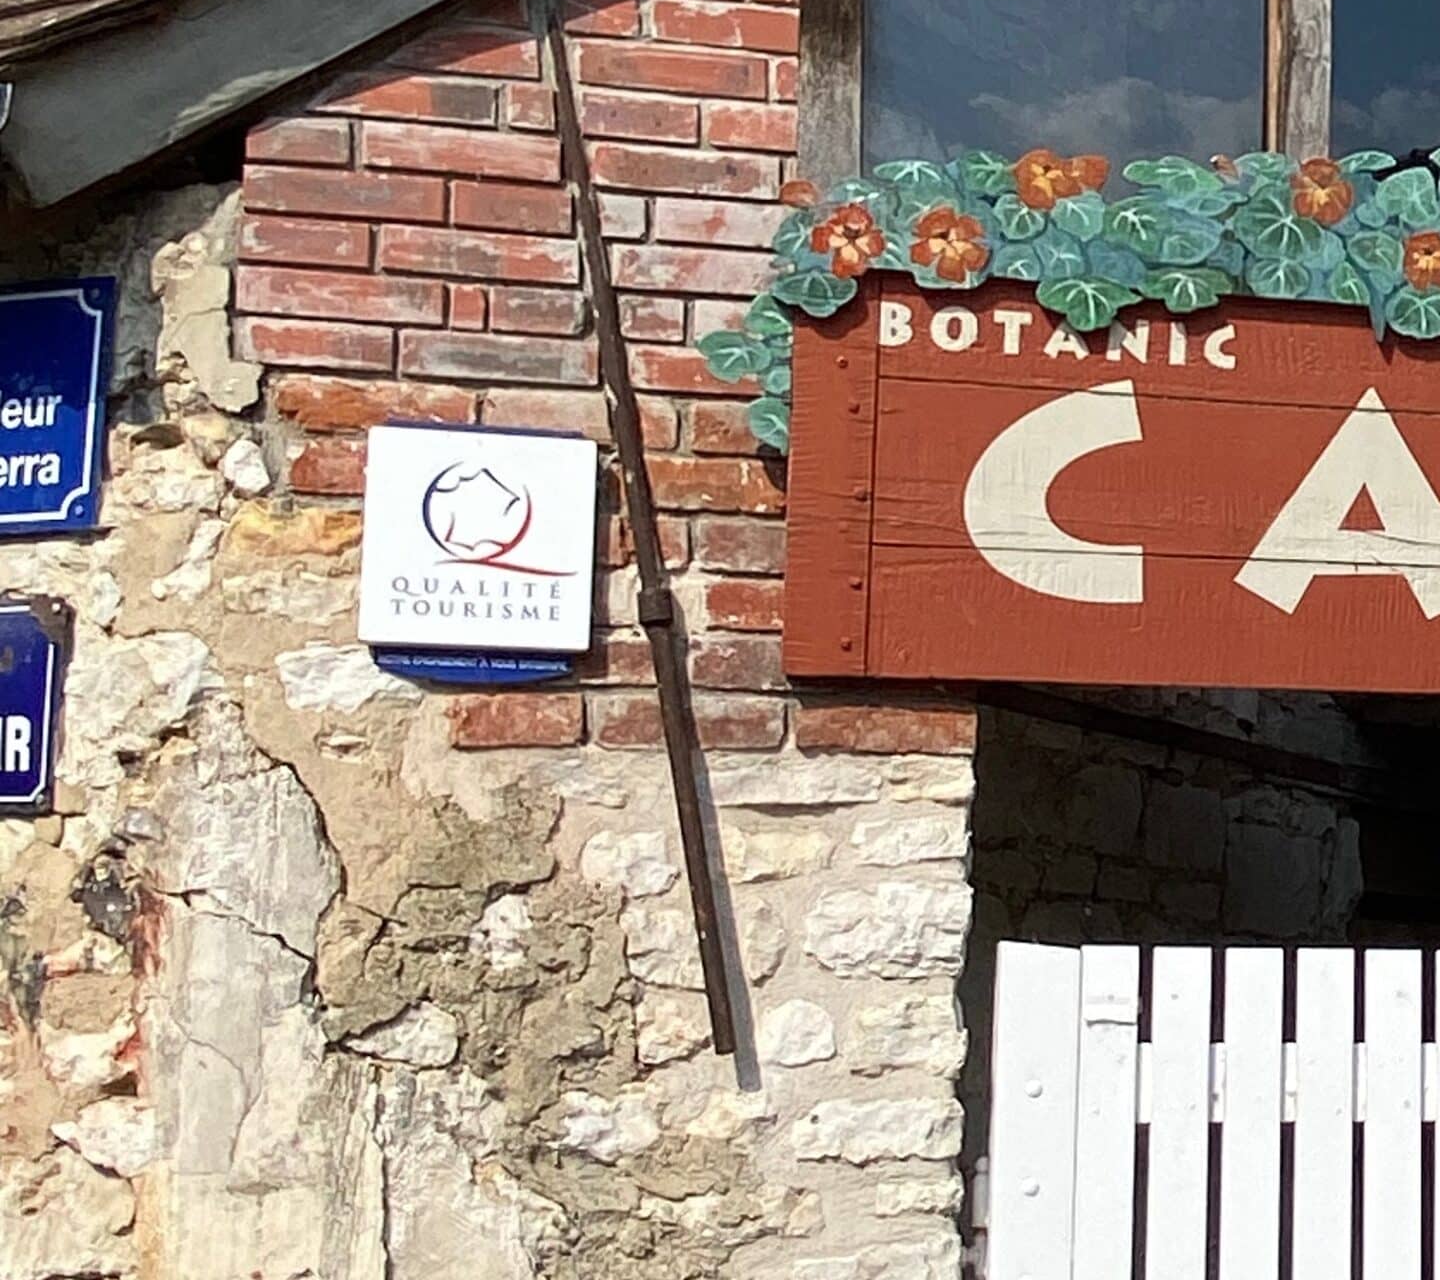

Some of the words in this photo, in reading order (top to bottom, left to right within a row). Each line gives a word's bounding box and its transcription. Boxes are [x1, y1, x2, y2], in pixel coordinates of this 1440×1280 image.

[878, 300, 1237, 371] BOTANIC
[0, 390, 63, 430] eur
[390, 576, 562, 600] QUALITÉ
[389, 598, 561, 622] TOURISME
